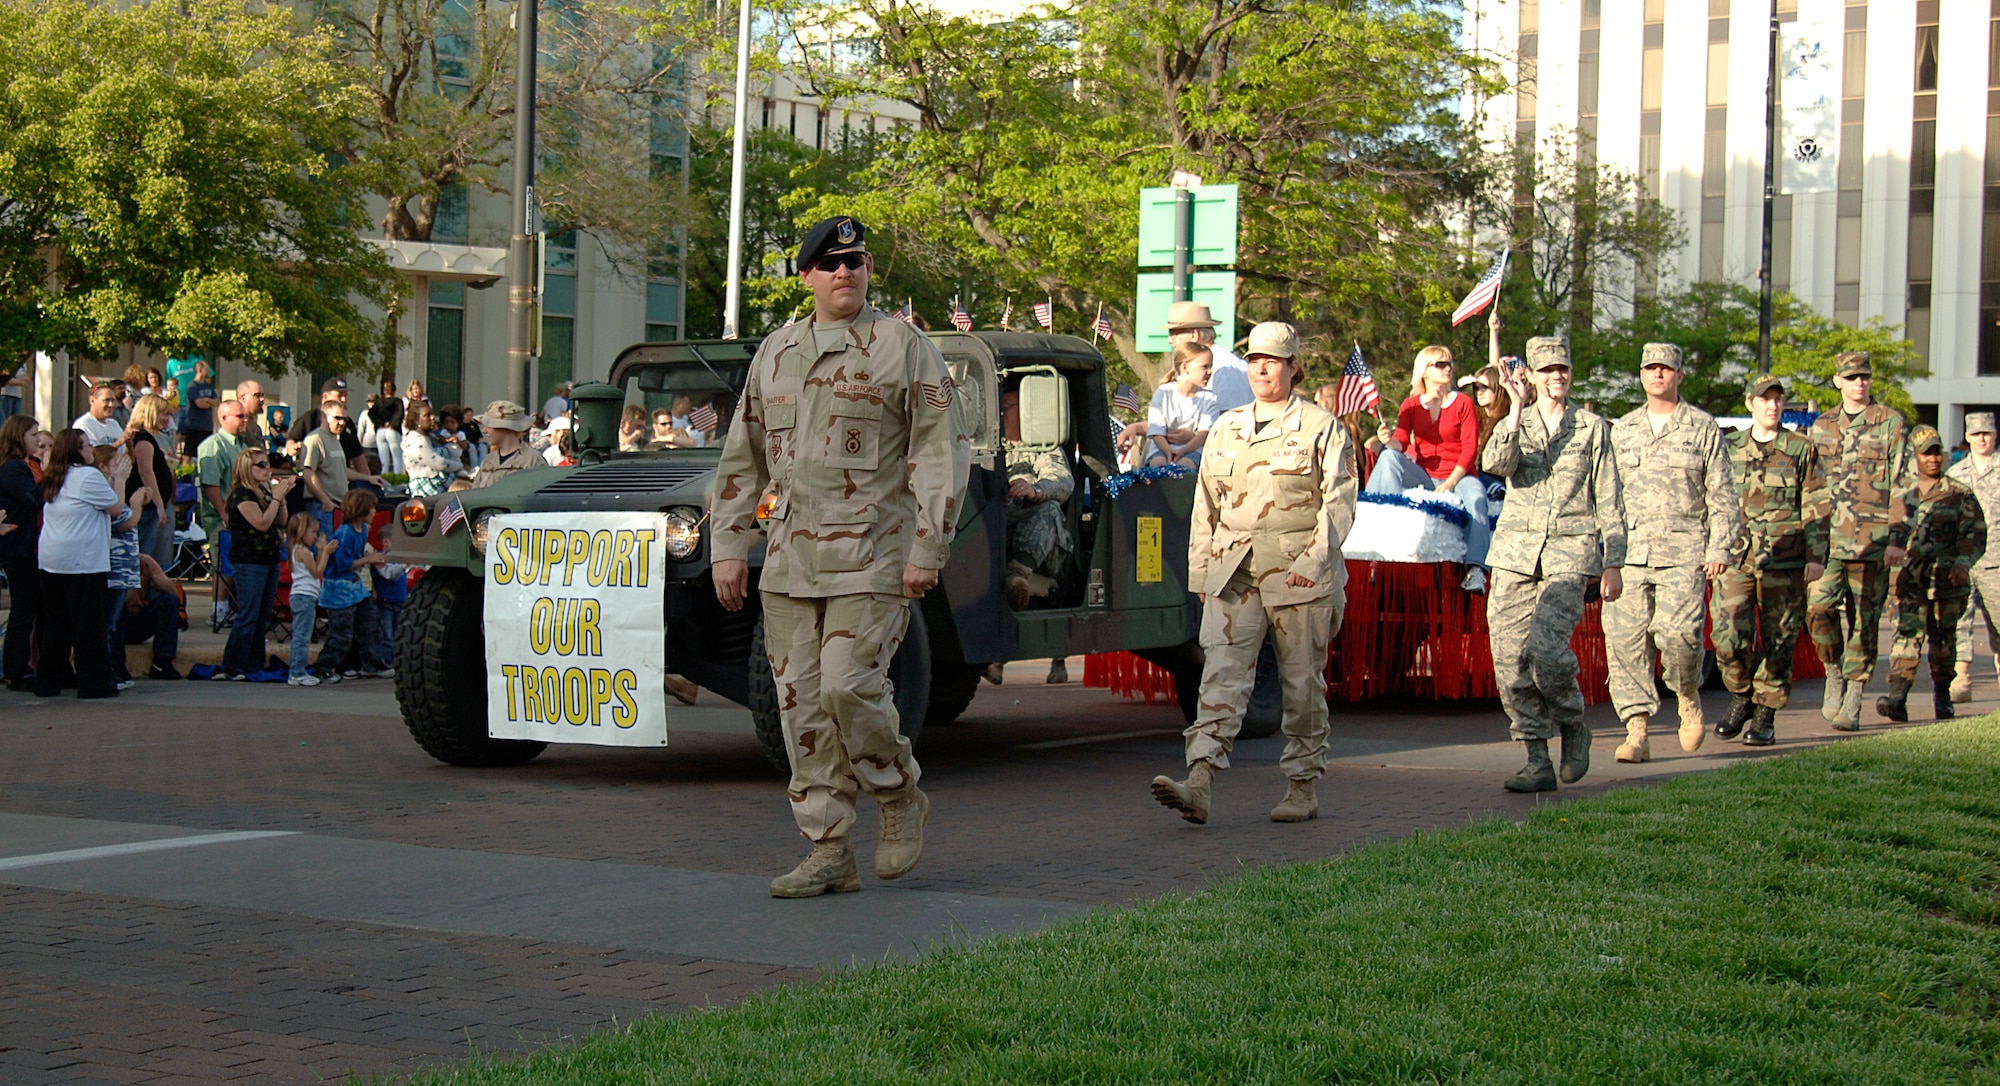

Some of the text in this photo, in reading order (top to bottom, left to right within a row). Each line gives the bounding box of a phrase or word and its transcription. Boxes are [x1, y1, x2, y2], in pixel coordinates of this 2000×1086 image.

[849, 384, 860, 392] AIR
[860, 385, 882, 395] FORCE
[494, 528, 656, 588] SUPPORT
[1151, 531, 1157, 547] 1
[530, 597, 603, 656] OUR
[501, 664, 638, 729] TROOPS
